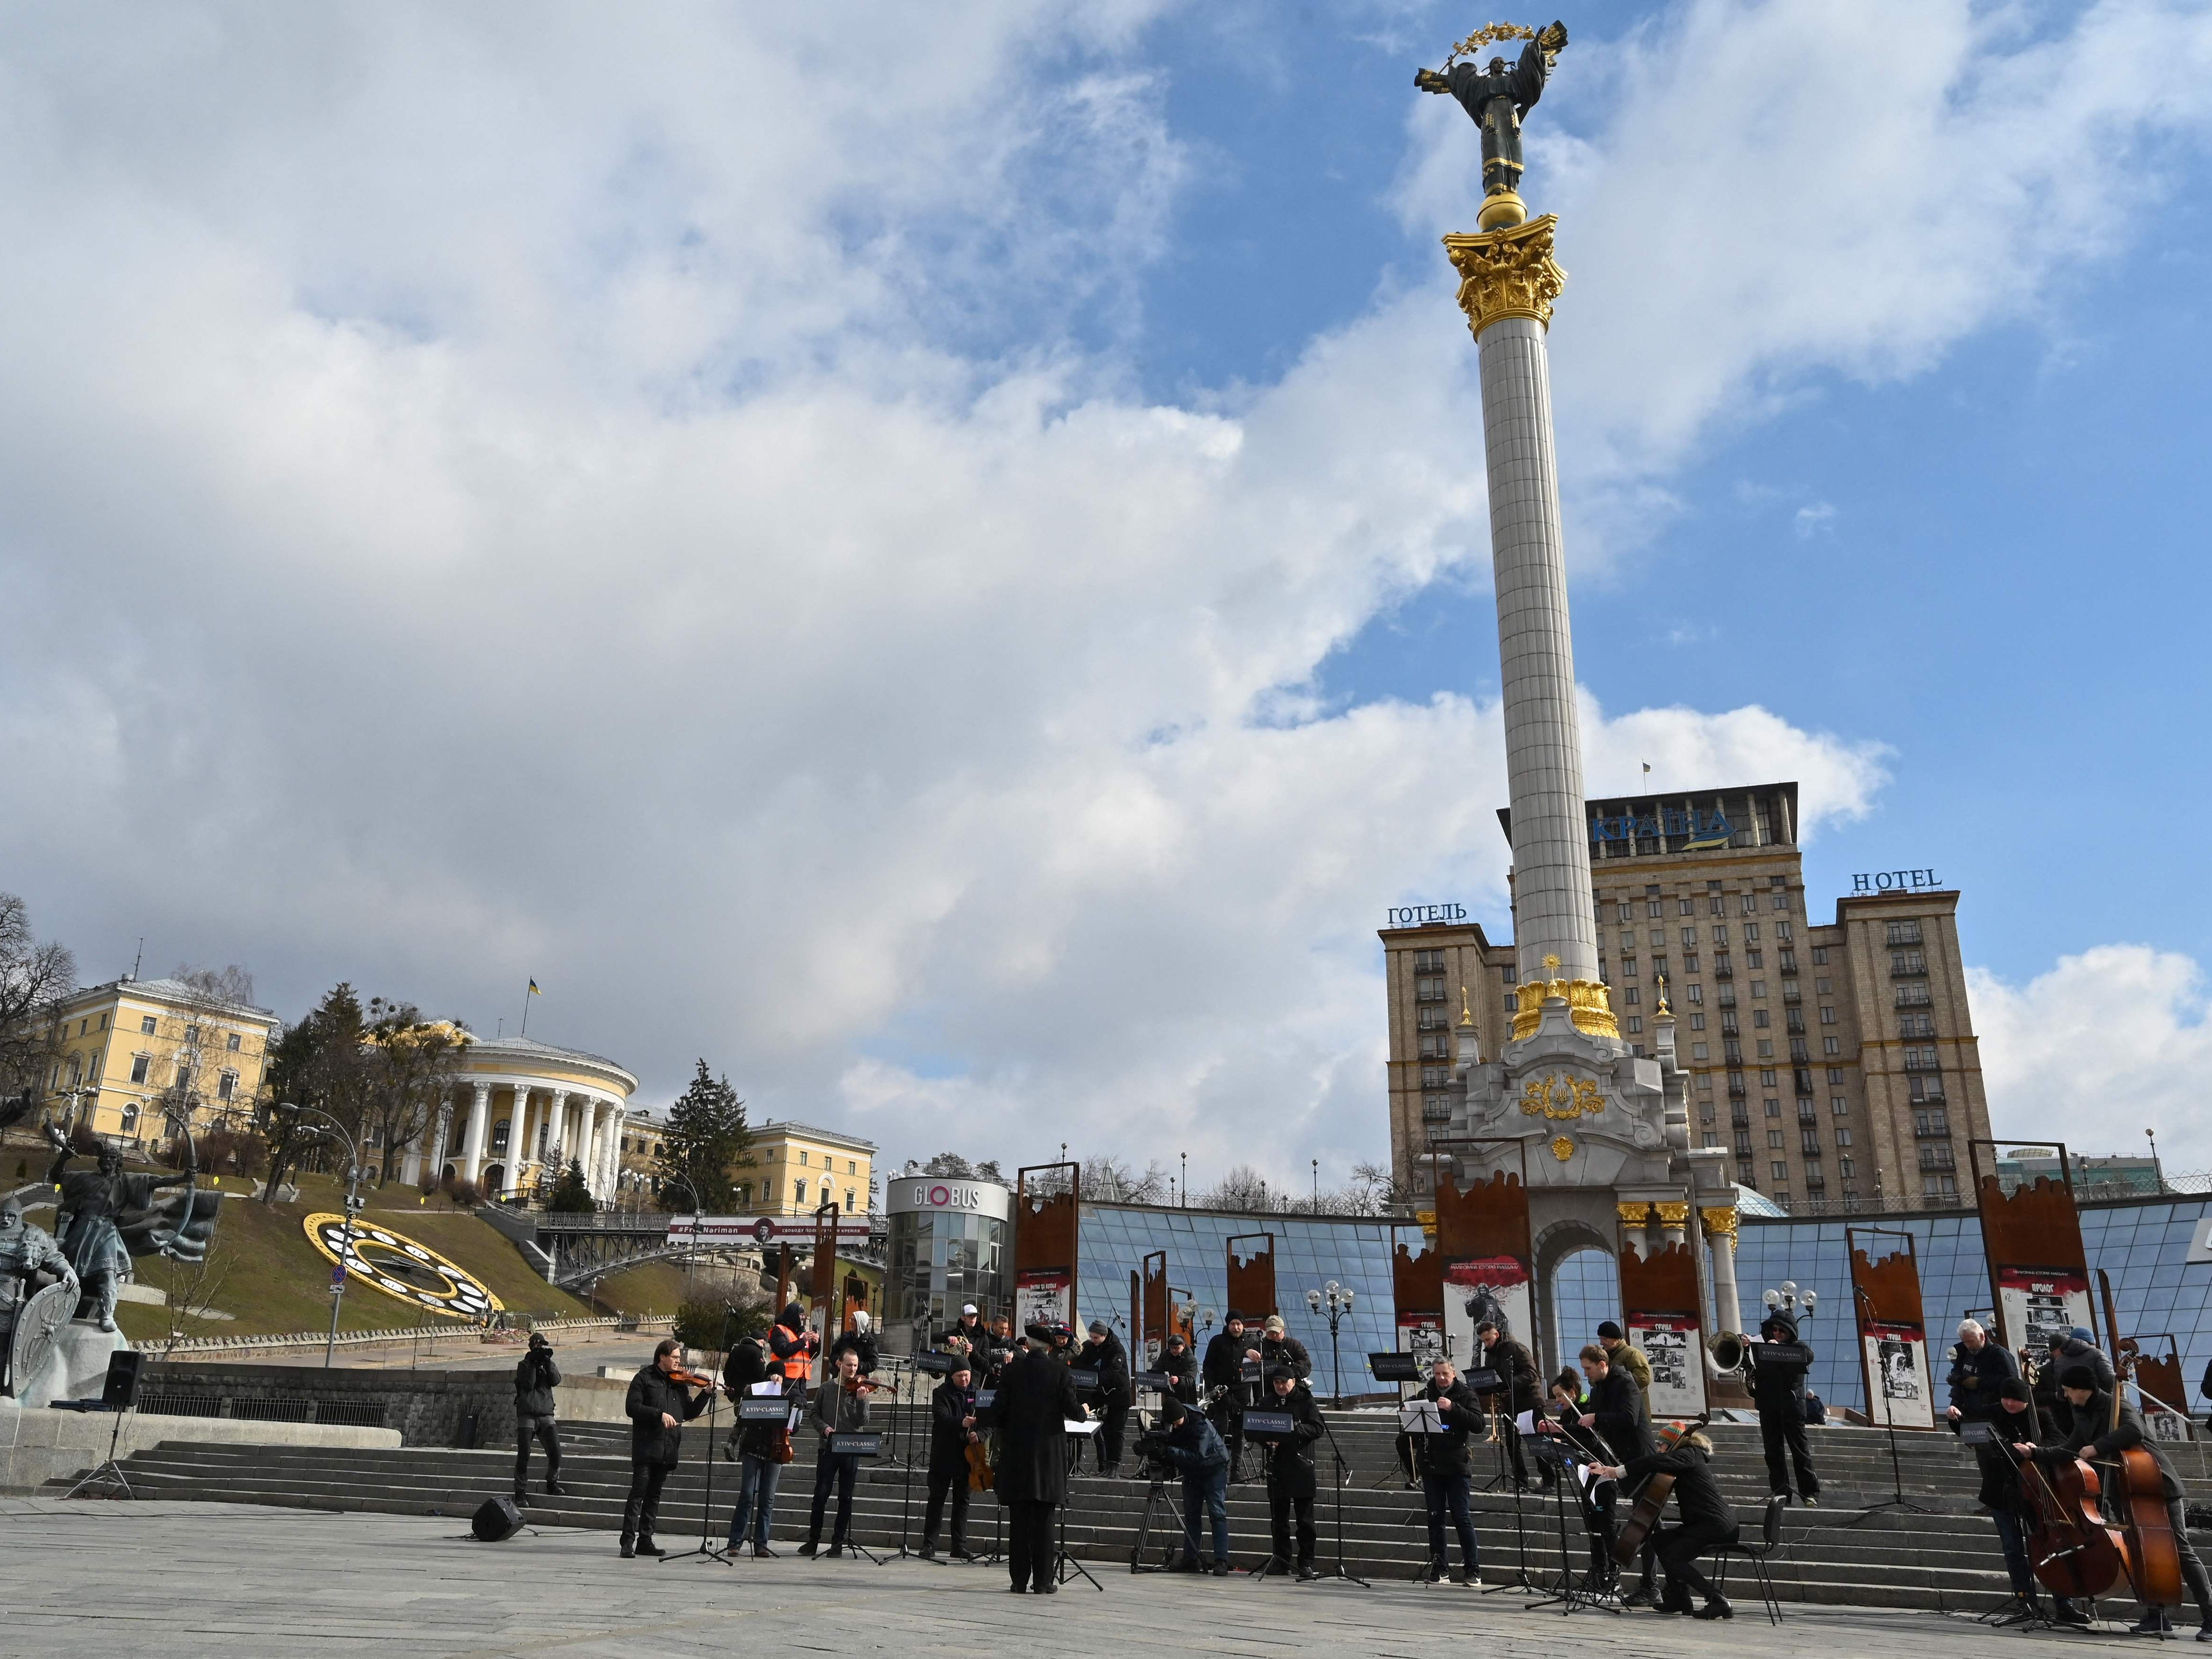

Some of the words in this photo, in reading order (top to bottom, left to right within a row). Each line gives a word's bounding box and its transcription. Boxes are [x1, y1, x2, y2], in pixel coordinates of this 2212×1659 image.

[1592, 808, 1734, 841] КРАЇНА
[1852, 869, 1943, 891] HOTEL
[1387, 903, 1467, 923] ГОТЕЛЬ
[914, 1186, 979, 1209] GLOBUS
[2031, 1283, 2054, 1293] ПРОЛОГ
[1963, 1364, 1977, 1373] PRES
